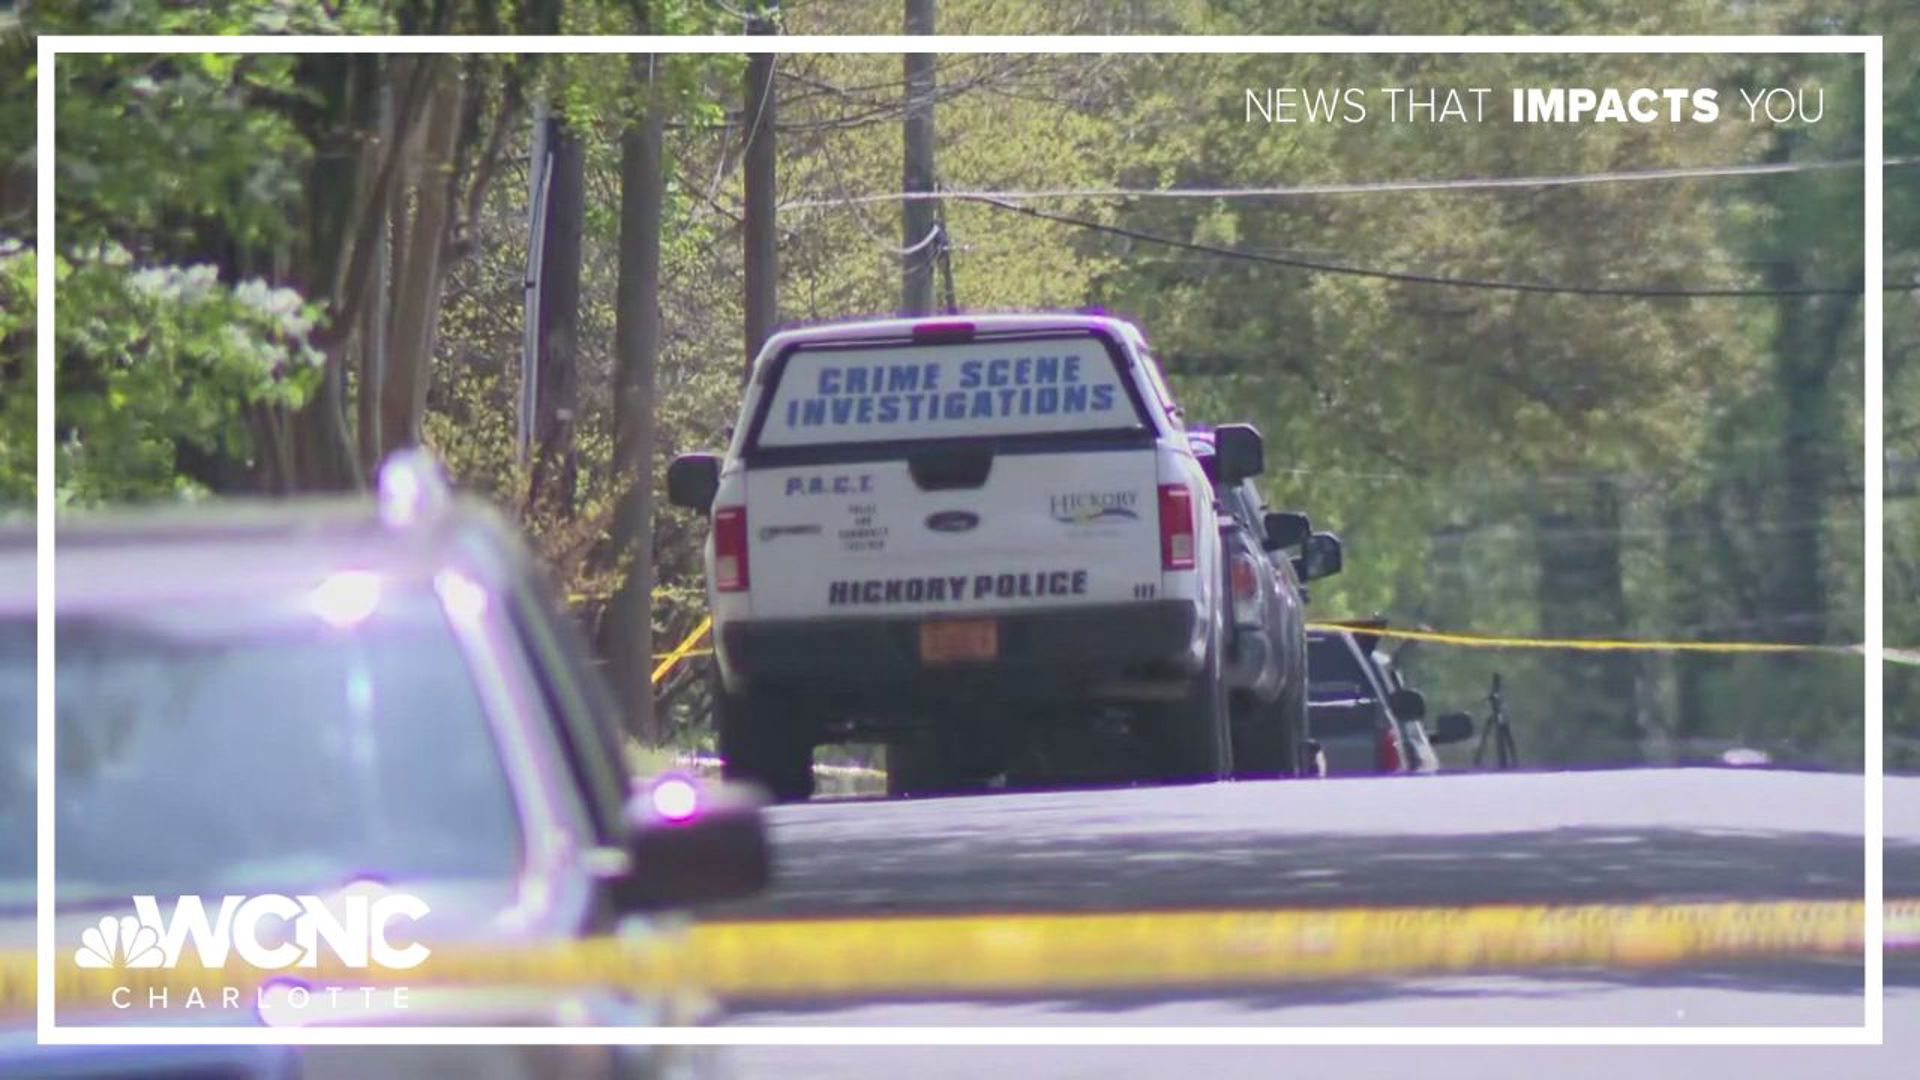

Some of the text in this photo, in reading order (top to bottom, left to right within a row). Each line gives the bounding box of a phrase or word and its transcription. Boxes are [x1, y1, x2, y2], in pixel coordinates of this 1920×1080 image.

[818, 355, 1080, 396] CRIME SCENE
[785, 384, 1115, 427] INVESTIGATIONS
[828, 570, 1088, 605] HICKORY POLICE
